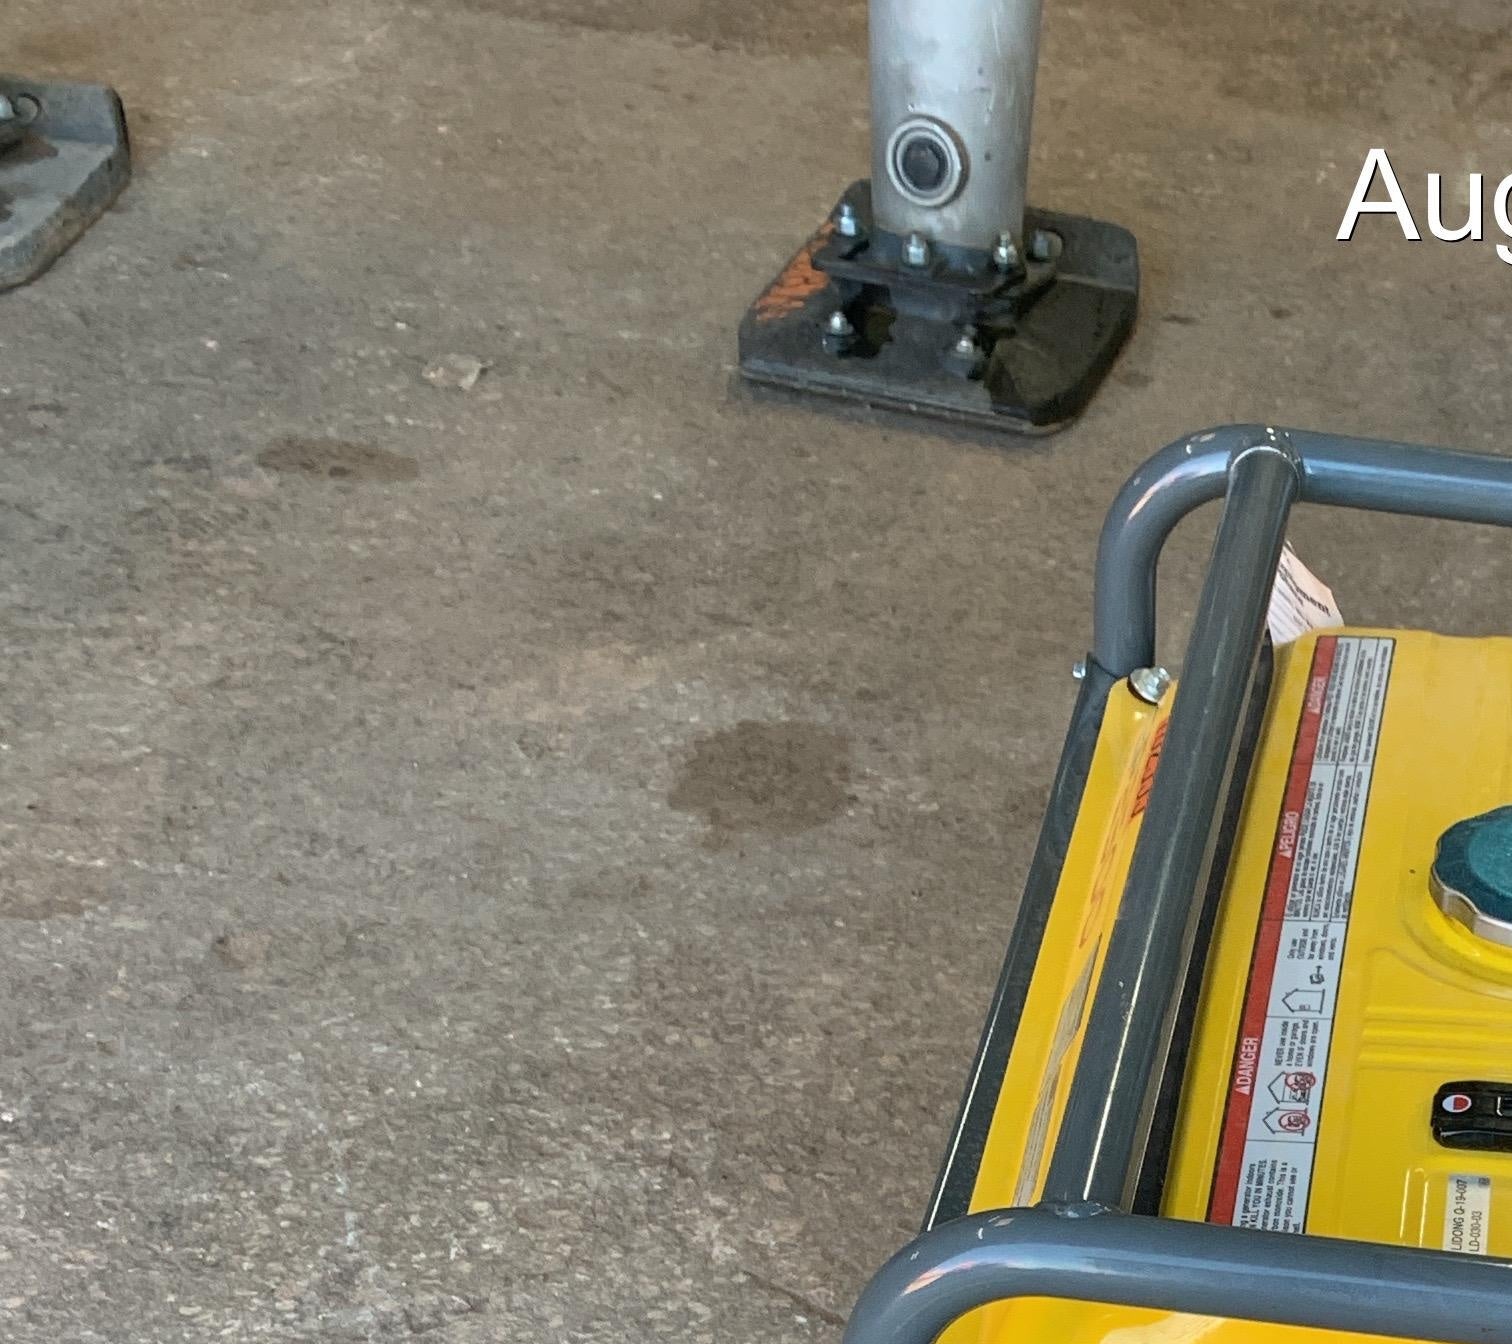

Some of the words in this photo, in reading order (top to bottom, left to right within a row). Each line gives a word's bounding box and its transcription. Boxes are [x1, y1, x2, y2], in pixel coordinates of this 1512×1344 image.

[1279, 811, 1300, 851] PELIGRO
[1235, 1037, 1259, 1086] DANGER
[1450, 1217, 1465, 1251] LIDONG
